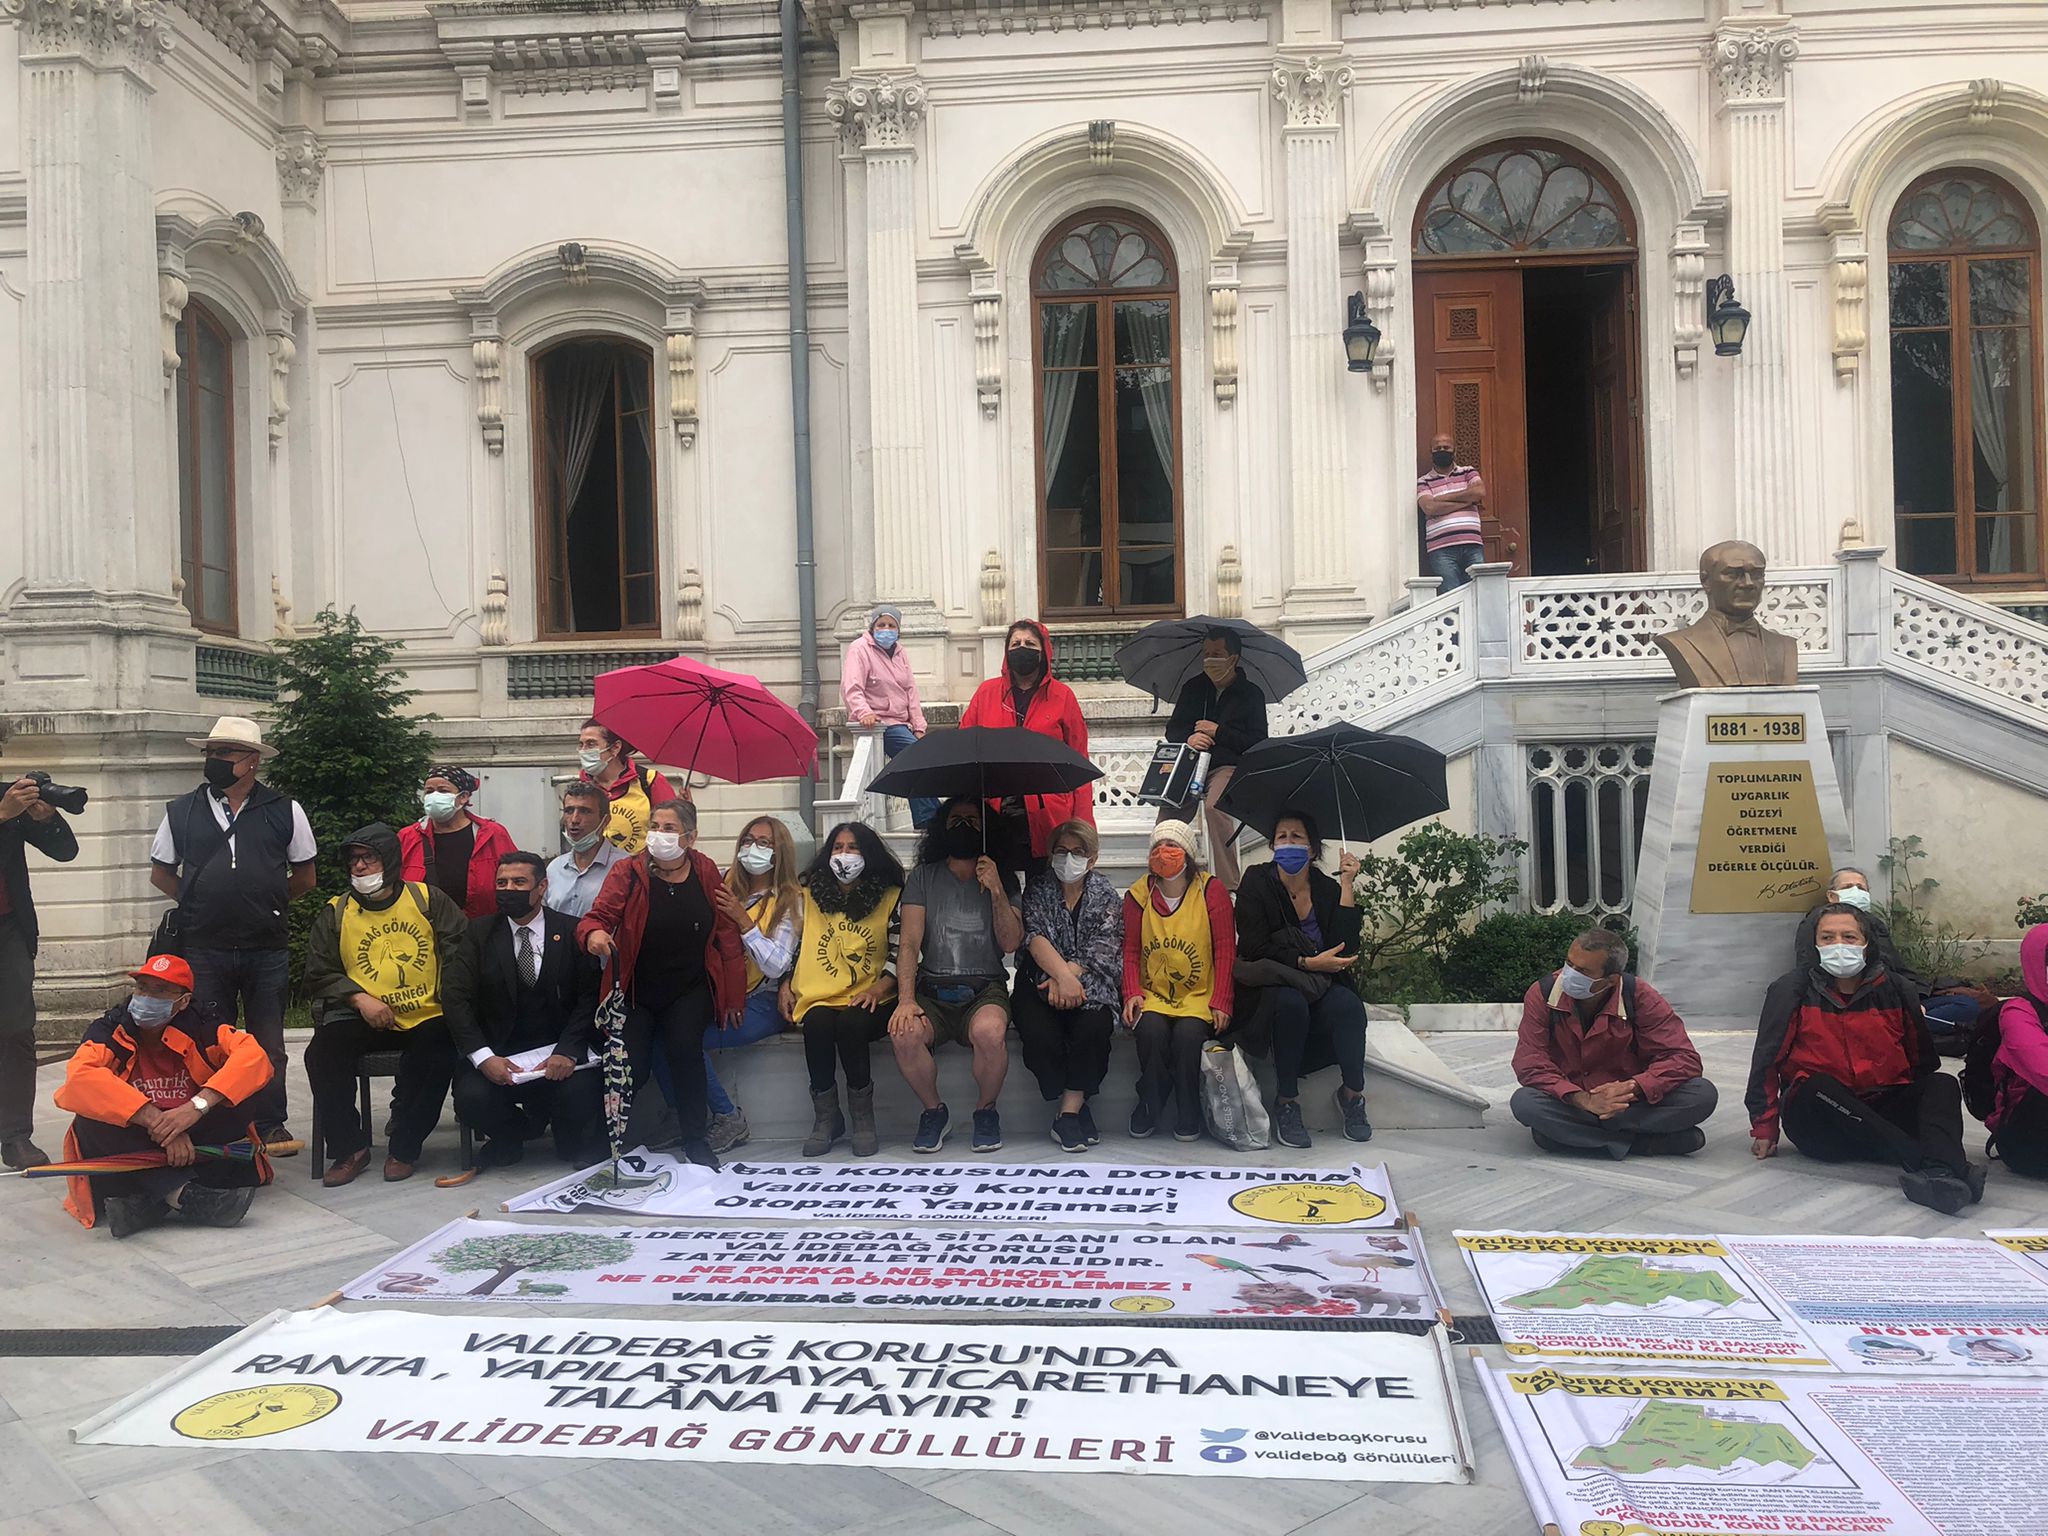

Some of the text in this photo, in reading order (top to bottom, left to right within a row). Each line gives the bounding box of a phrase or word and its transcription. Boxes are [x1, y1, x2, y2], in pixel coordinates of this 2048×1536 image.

[1711, 721, 1747, 736] 1881
[1763, 721, 1801, 736] 1938
[1717, 773, 1802, 784] TOPLUMLARIN
[1731, 791, 1790, 801] UYGARLIK
[1739, 807, 1783, 818] DÜZEYİ
[1726, 825, 1797, 836] ÖĞRETMENE
[1739, 842, 1785, 854] VERDİĞİ
[1708, 860, 1819, 874] DEĞERLE ÖLÇÜLÜR.
[146, 1088, 187, 1104] Tours
[835, 1168, 1090, 1179] KORUSUNA
[742, 1181, 959, 1196] Validebağ
[714, 1195, 1179, 1214] Otopark Yapılamaz!
[918, 1213, 1048, 1221] GÖNÜLLÜLERİ
[614, 1229, 1236, 1246] 1.DERECE DOĞAL SİT ALANI OLAN
[1462, 1235, 1580, 1247] VALİDEBAĞ
[1586, 1239, 1718, 1249] KORUSU'NA
[725, 1241, 1105, 1254] VALİDEBAĞ KORUSU
[660, 1251, 1164, 1267] ZATEN MİLLETİN MALIDIR.
[689, 1265, 737, 1274] NE
[887, 1267, 933, 1276] NE
[943, 1268, 1108, 1279] BAHÇEYE
[597, 1274, 647, 1283] NE
[651, 1274, 699, 1284] DE
[704, 1275, 828, 1286] RANTA
[830, 1275, 1172, 1291] DÖNÜŞTÜRÜLEMEZ
[672, 1291, 857, 1304] VALİDEBAĞ
[863, 1294, 1102, 1308] GÖNÜLLÜLERİ
[463, 1331, 1180, 1368] VALİDEBAĞ KORUSU'NDA
[896, 1363, 1417, 1399] TİCARETHANEYE
[1514, 1370, 1776, 1391] VALİDEBAĞ KORUSU'NA
[1534, 1379, 1765, 1399] DOKUNMA!
[543, 1385, 780, 1413] TALANA
[801, 1393, 992, 1419] HAYIR
[204, 1429, 244, 1437] 1998
[366, 1417, 1176, 1463] VALİDEBAĞ GÖNÜLLÜLERİ
[1254, 1449, 1457, 1466] Validebağ Gönüllüleri
[1594, 1503, 1680, 1519] VALİDEBAĞ
[1724, 1521, 1781, 1530] KORU
